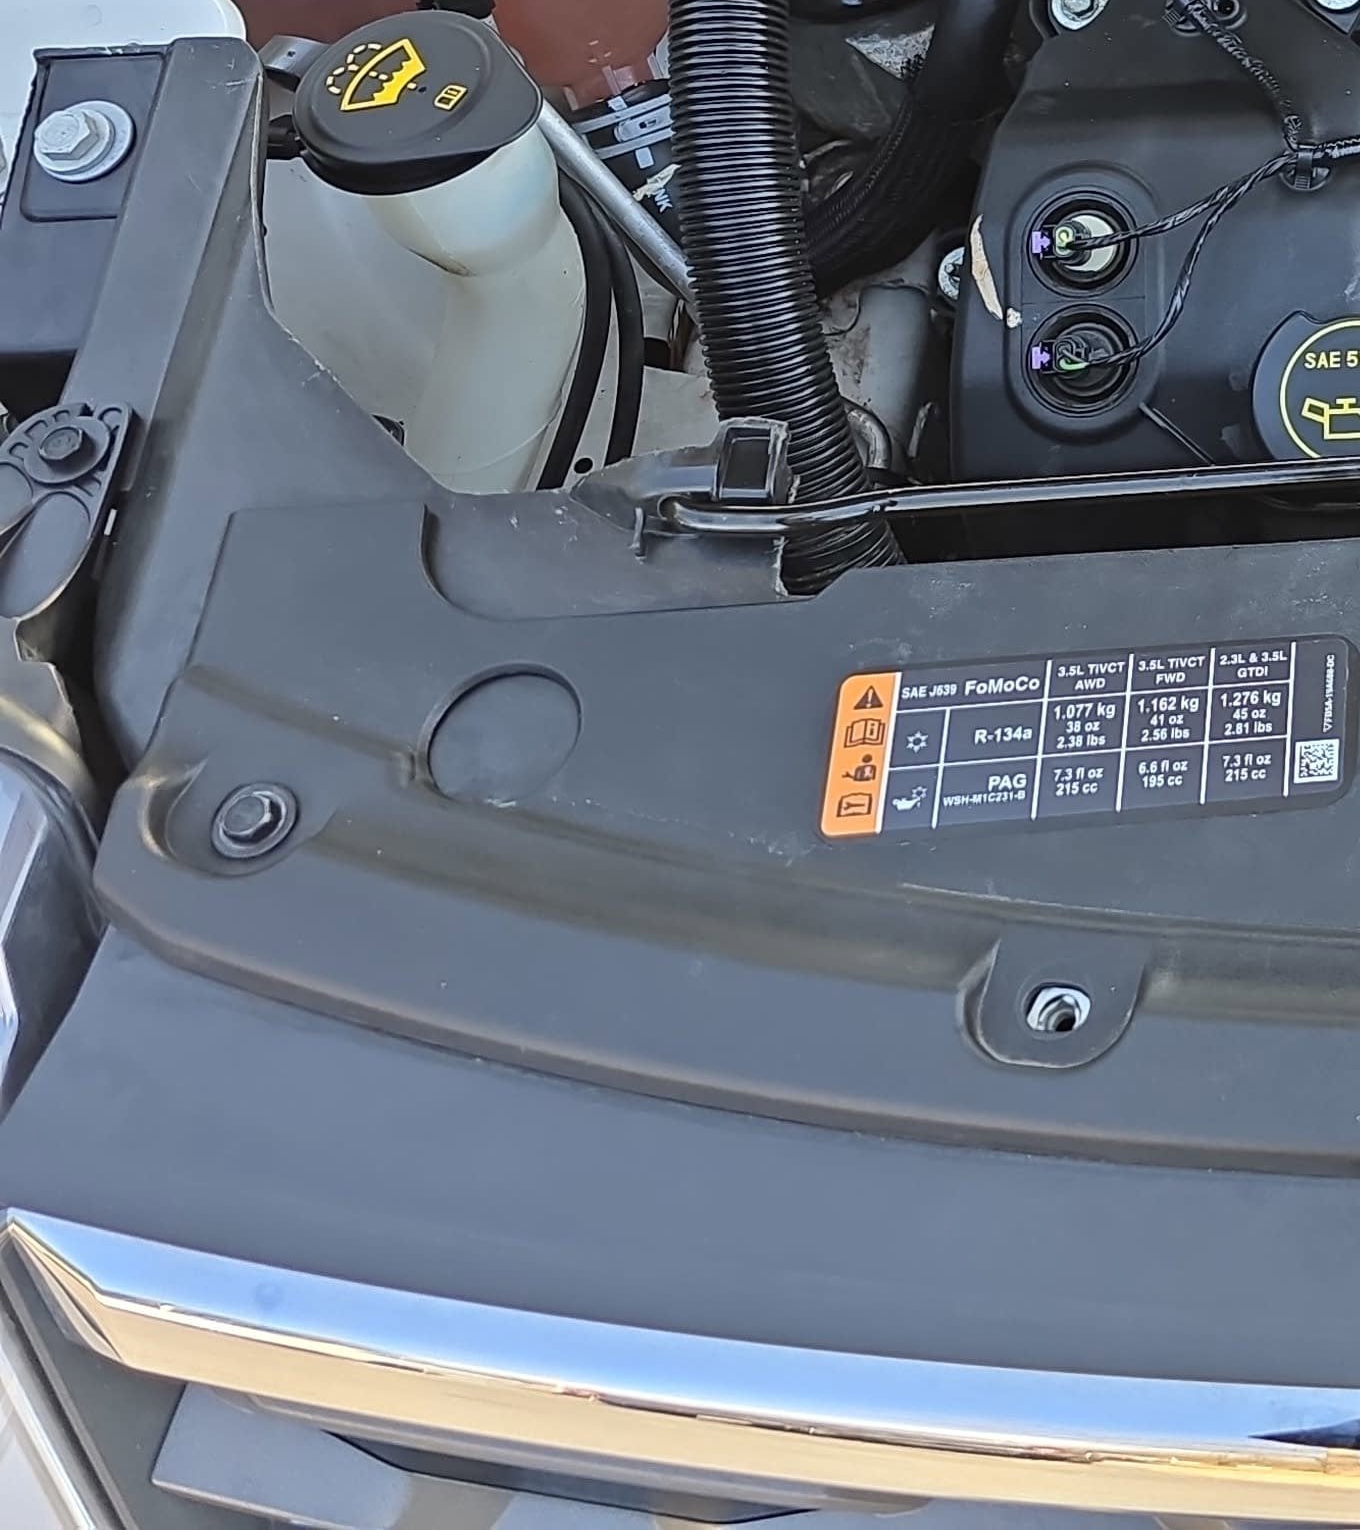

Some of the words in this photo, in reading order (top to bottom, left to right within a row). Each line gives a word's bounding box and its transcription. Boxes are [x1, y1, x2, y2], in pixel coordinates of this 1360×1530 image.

[1304, 351, 1341, 369] SAE
[1138, 659, 1165, 671] 3.5L
[1219, 654, 1246, 666] 2.3L
[1249, 653, 1258, 663] &
[1261, 650, 1288, 662] 3.5L
[1057, 665, 1085, 678] 3.5L
[1155, 672, 1186, 685] FWD
[901, 686, 927, 699] SAE
[928, 684, 958, 697] J639
[964, 676, 1041, 696] FoMoCo
[1074, 678, 1106, 691] AWD
[1137, 697, 1177, 714] 1.162
[1180, 695, 1199, 712] kg
[1220, 691, 1260, 708] 1.276
[1263, 690, 1282, 706] kg
[1054, 703, 1094, 720] 1.077
[1096, 702, 1116, 719] kg
[1232, 708, 1248, 720] 45
[1251, 709, 1266, 719] oz
[1066, 721, 1080, 733] 38
[1084, 721, 1100, 731] oz
[1150, 714, 1165, 727] 41
[1168, 714, 1184, 725] oz
[974, 726, 1032, 745] R-134a
[1141, 729, 1168, 742] 2.56
[1170, 727, 1190, 739] lbs
[1224, 723, 1253, 736] 2.81
[1254, 721, 1273, 733] lbs
[1056, 736, 1083, 749] 2.38
[1086, 734, 1106, 747] lbs
[1138, 762, 1158, 775] 6.6
[1161, 760, 1169, 772] fl
[1172, 761, 1188, 771] oz
[1222, 755, 1241, 768] 7.3
[1244, 754, 1253, 766] fl
[1256, 754, 1272, 765] oz
[988, 773, 1027, 791] PAG
[1053, 768, 1073, 782] 7.3
[1075, 767, 1085, 779] fl
[1087, 767, 1104, 778] oz
[1142, 775, 1165, 788] 195
[1167, 775, 1183, 786] cc
[1225, 769, 1248, 782] 215
[1251, 769, 1266, 780] cc
[1055, 783, 1080, 796] 215
[1082, 782, 1098, 793] cc
